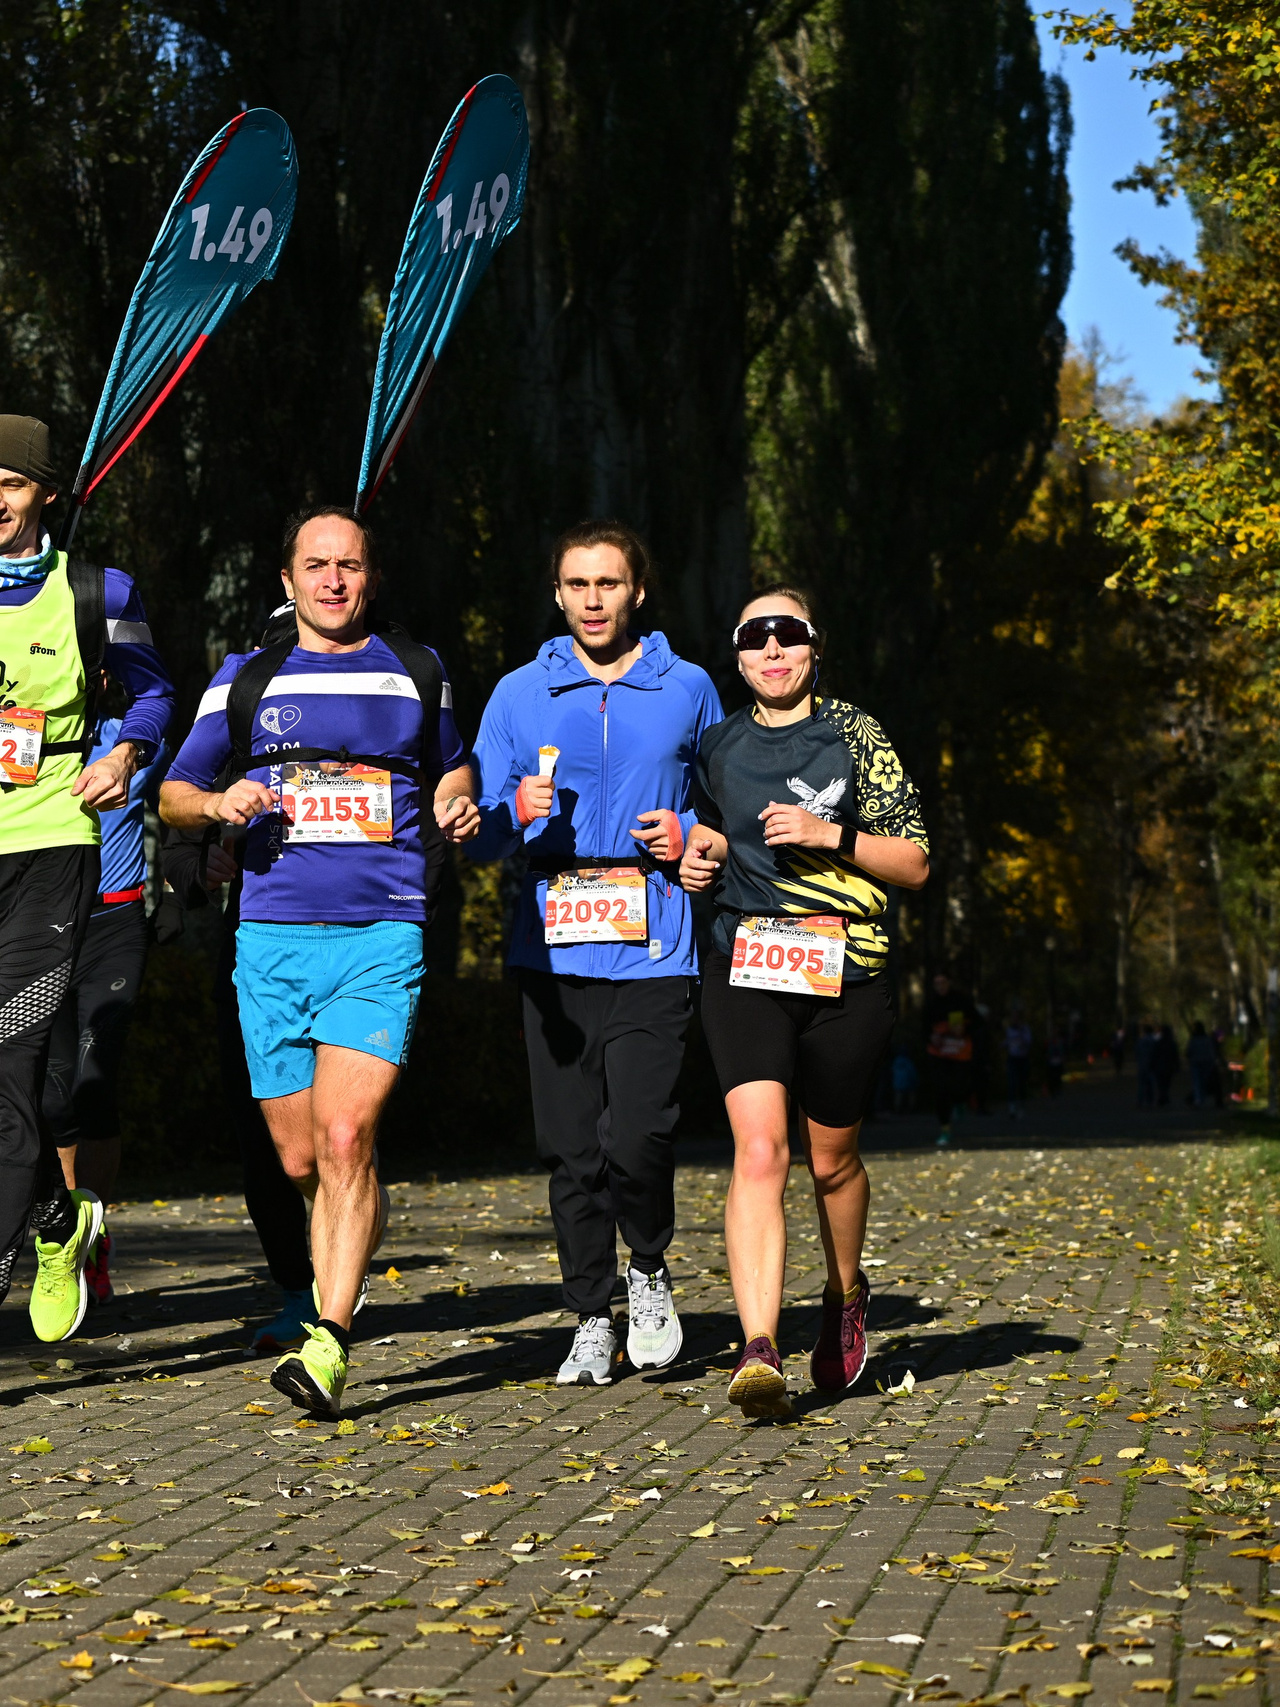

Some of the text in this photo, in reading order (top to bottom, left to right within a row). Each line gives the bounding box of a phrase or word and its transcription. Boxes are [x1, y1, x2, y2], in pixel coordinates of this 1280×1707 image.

[436, 173, 511, 255] 1.49
[189, 203, 273, 264] 1.49
[29, 644, 56, 656] grom
[301, 796, 371, 822] 2153
[558, 898, 628, 924] 2092
[746, 942, 824, 974] 2095
